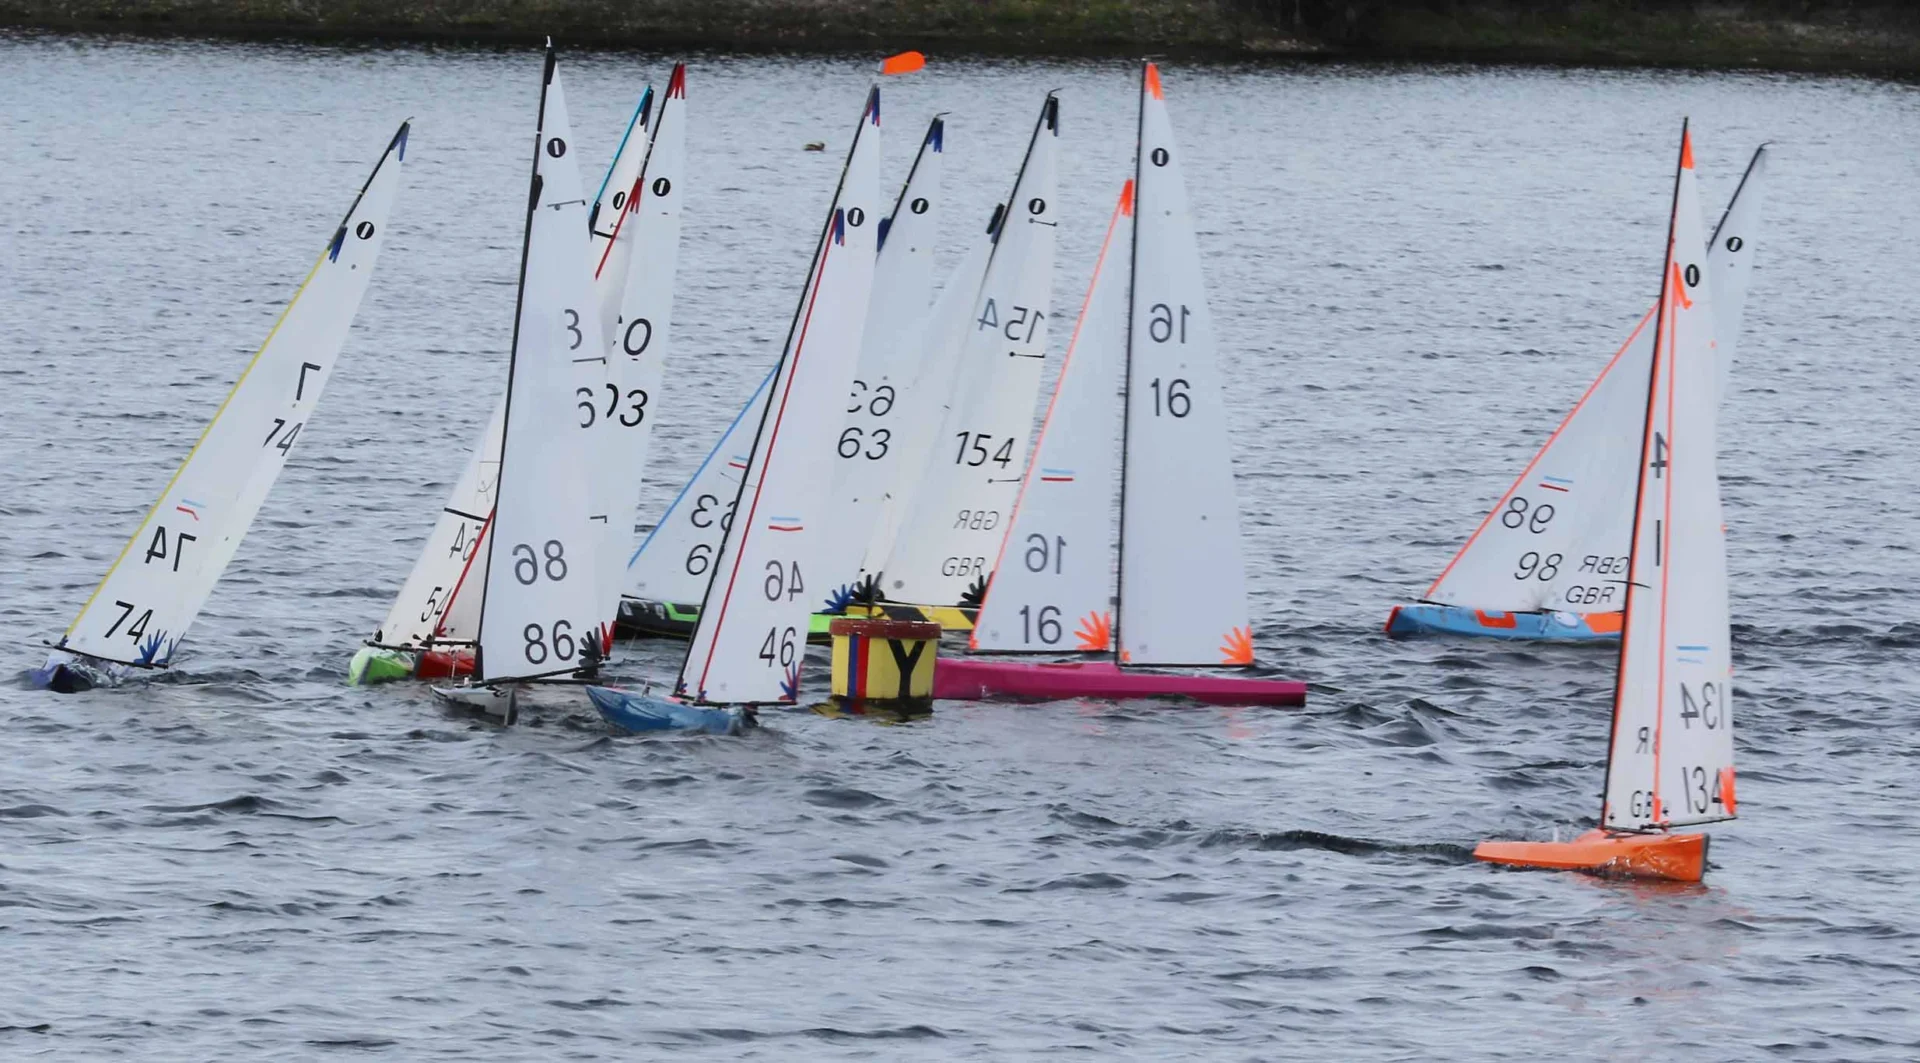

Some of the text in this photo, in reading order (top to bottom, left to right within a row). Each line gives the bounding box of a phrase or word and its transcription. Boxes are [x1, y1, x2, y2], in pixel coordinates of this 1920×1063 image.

[1151, 377, 1191, 418] 16
[263, 418, 303, 457] 74
[837, 426, 891, 461] 63
[955, 431, 1015, 469] 154
[941, 556, 985, 577] GBR
[1514, 551, 1563, 581] 98
[1565, 585, 1616, 605] GBR
[104, 600, 153, 646] 74
[524, 619, 575, 665] 86
[1019, 605, 1062, 645] 16
[759, 626, 796, 667] 46
[886, 637, 927, 697] Y
